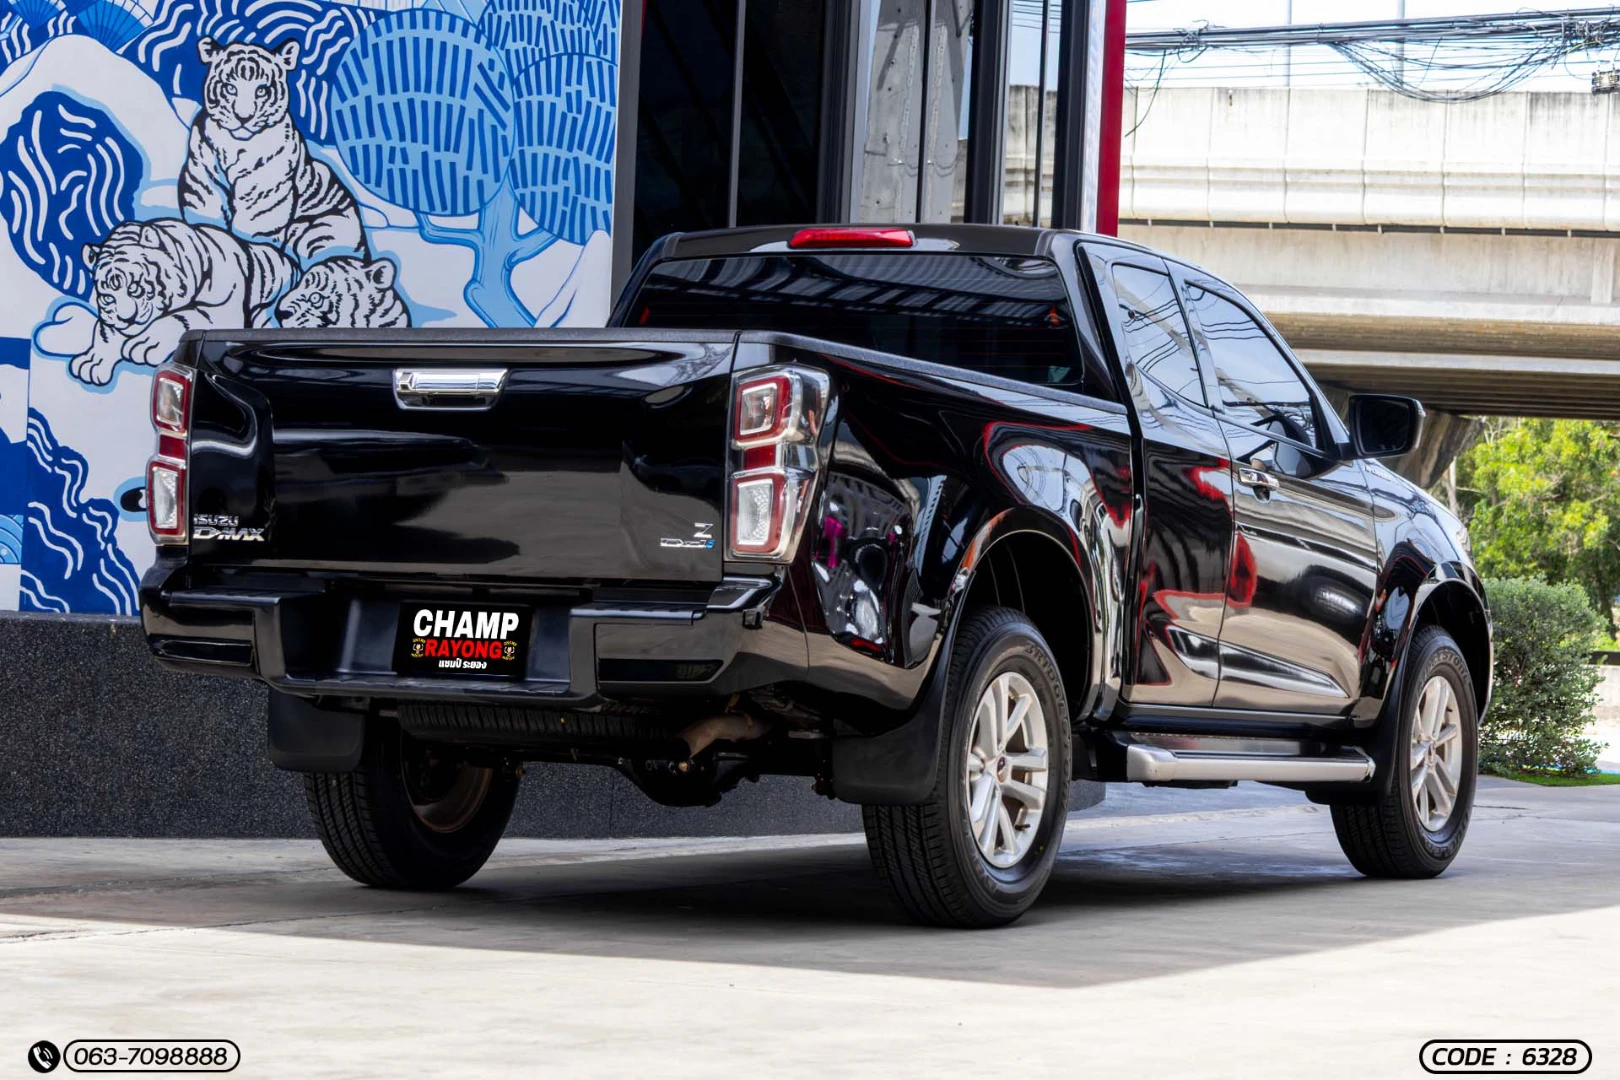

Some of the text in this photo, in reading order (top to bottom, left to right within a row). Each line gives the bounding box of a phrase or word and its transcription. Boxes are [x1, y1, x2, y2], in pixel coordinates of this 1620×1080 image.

[193, 514, 239, 527] ISUZU
[413, 609, 520, 639] CHAMP
[424, 639, 503, 659] RAYONG
[462, 660, 488, 670] ระยอง
